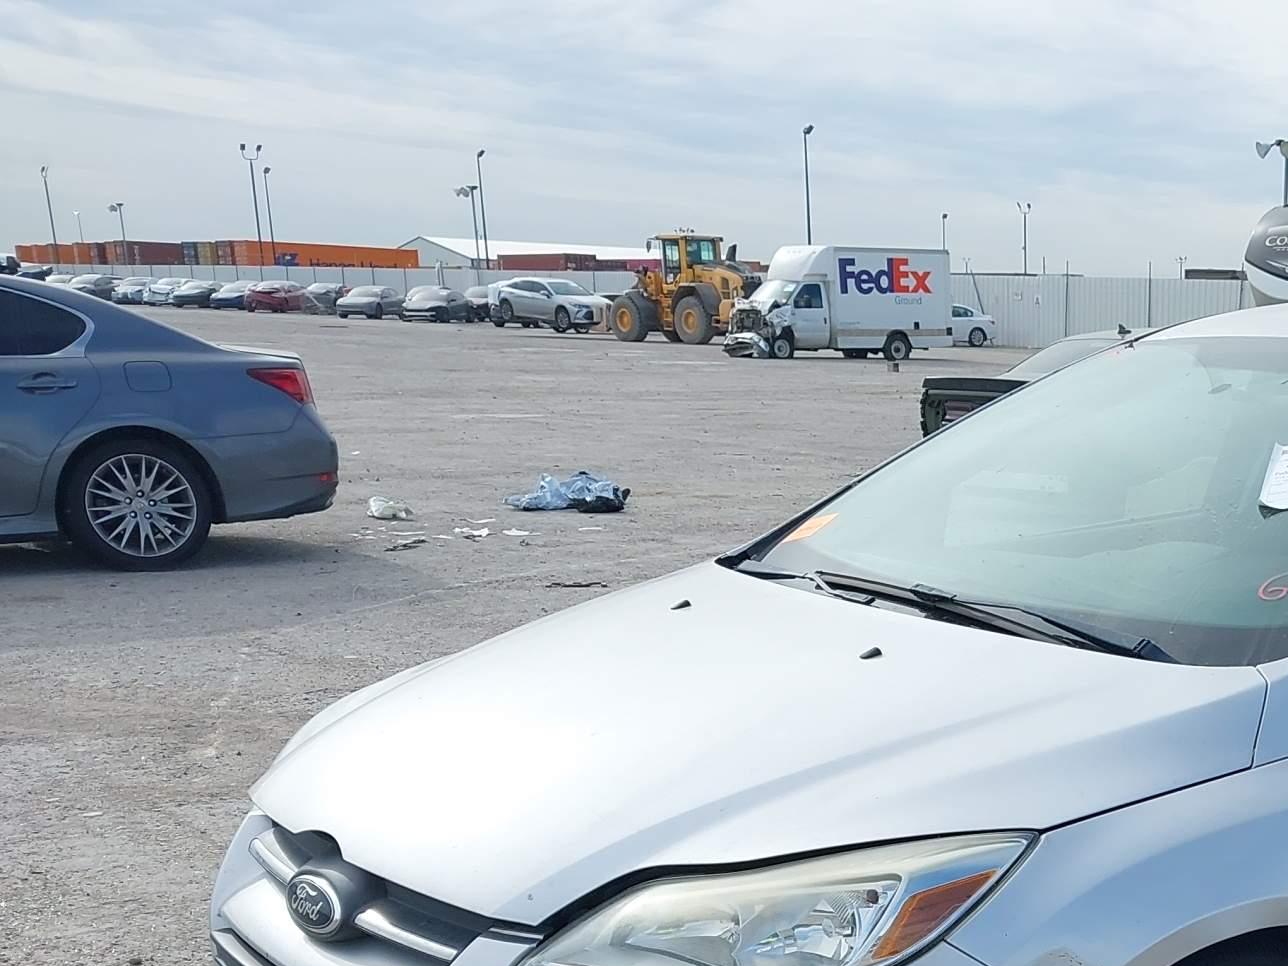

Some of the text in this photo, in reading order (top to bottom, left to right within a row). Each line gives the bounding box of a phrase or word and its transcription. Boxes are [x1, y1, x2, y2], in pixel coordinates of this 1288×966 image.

[838, 257, 932, 294] FedEx
[894, 295, 922, 304] Ground
[291, 883, 323, 920] Ford
